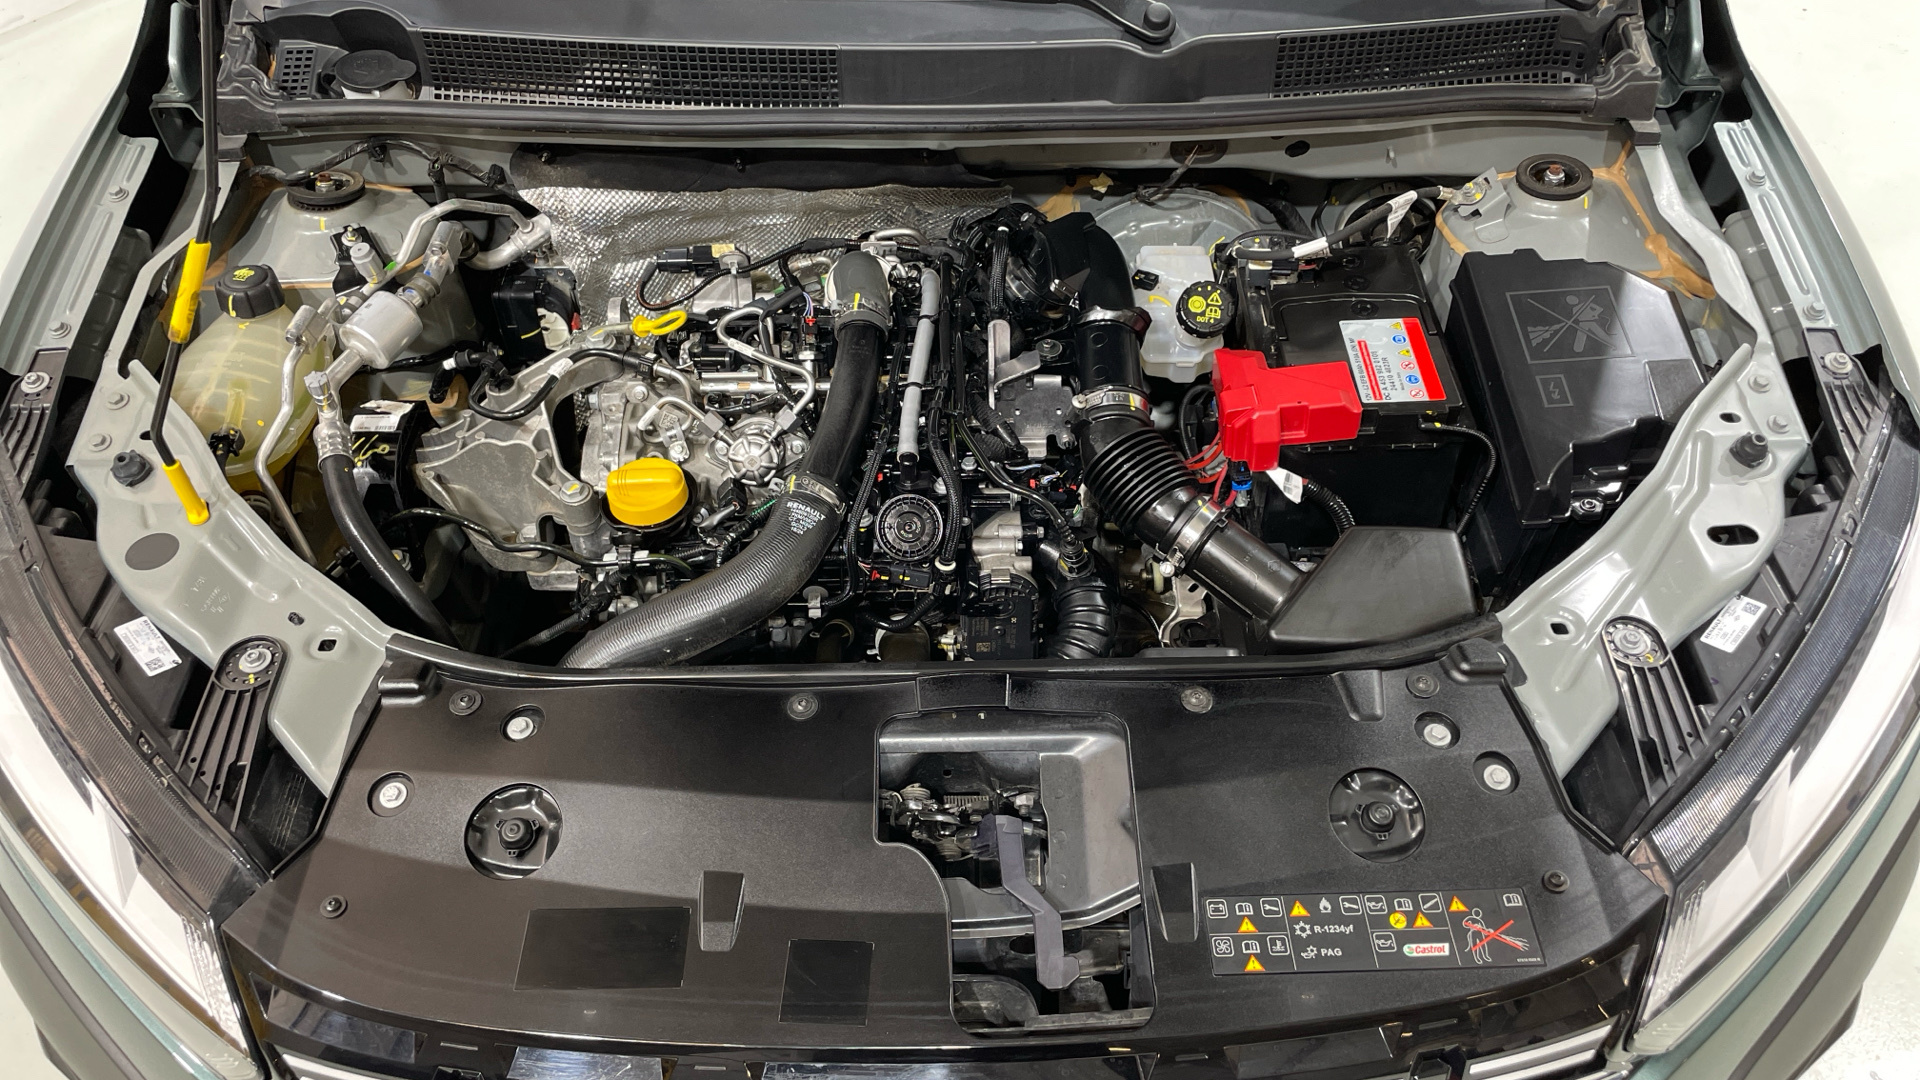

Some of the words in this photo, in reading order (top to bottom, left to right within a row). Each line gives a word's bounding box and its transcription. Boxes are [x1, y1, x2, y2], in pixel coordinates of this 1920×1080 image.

[1378, 376, 1387, 385] 453
[786, 502, 826, 520] RENAULT
[143, 620, 160, 639] RENAULT
[1704, 618, 1722, 639] RENAULT
[1314, 924, 1354, 934] R-1234yf
[1321, 948, 1342, 956] PAG
[1415, 945, 1446, 954] Castrol
